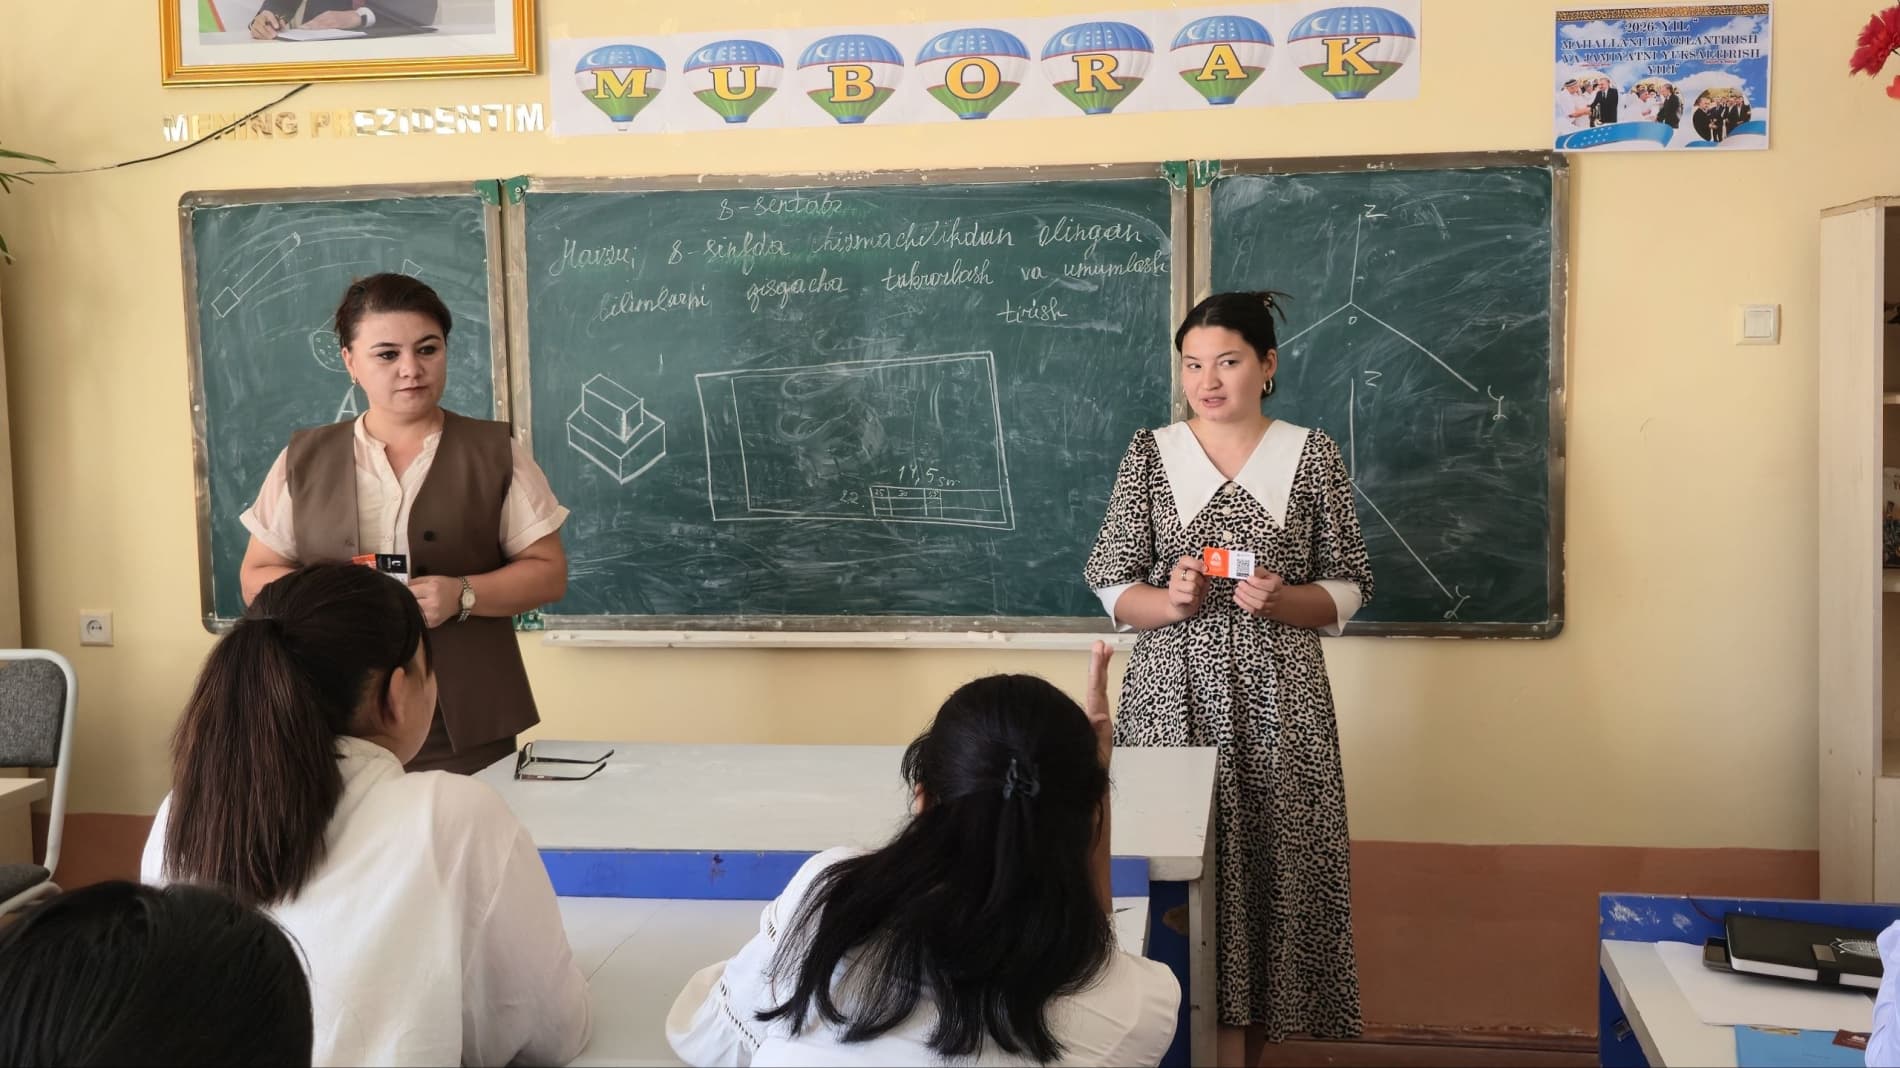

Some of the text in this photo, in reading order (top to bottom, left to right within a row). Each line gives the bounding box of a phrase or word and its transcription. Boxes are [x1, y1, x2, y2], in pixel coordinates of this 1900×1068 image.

[1623, 20, 1654, 33] 2026
[1562, 37, 1643, 50] MAHALLANI
[1562, 53, 1580, 64] VA
[163, 103, 544, 142] MENING PREZIDENTIM
[1021, 265, 1048, 281] va
